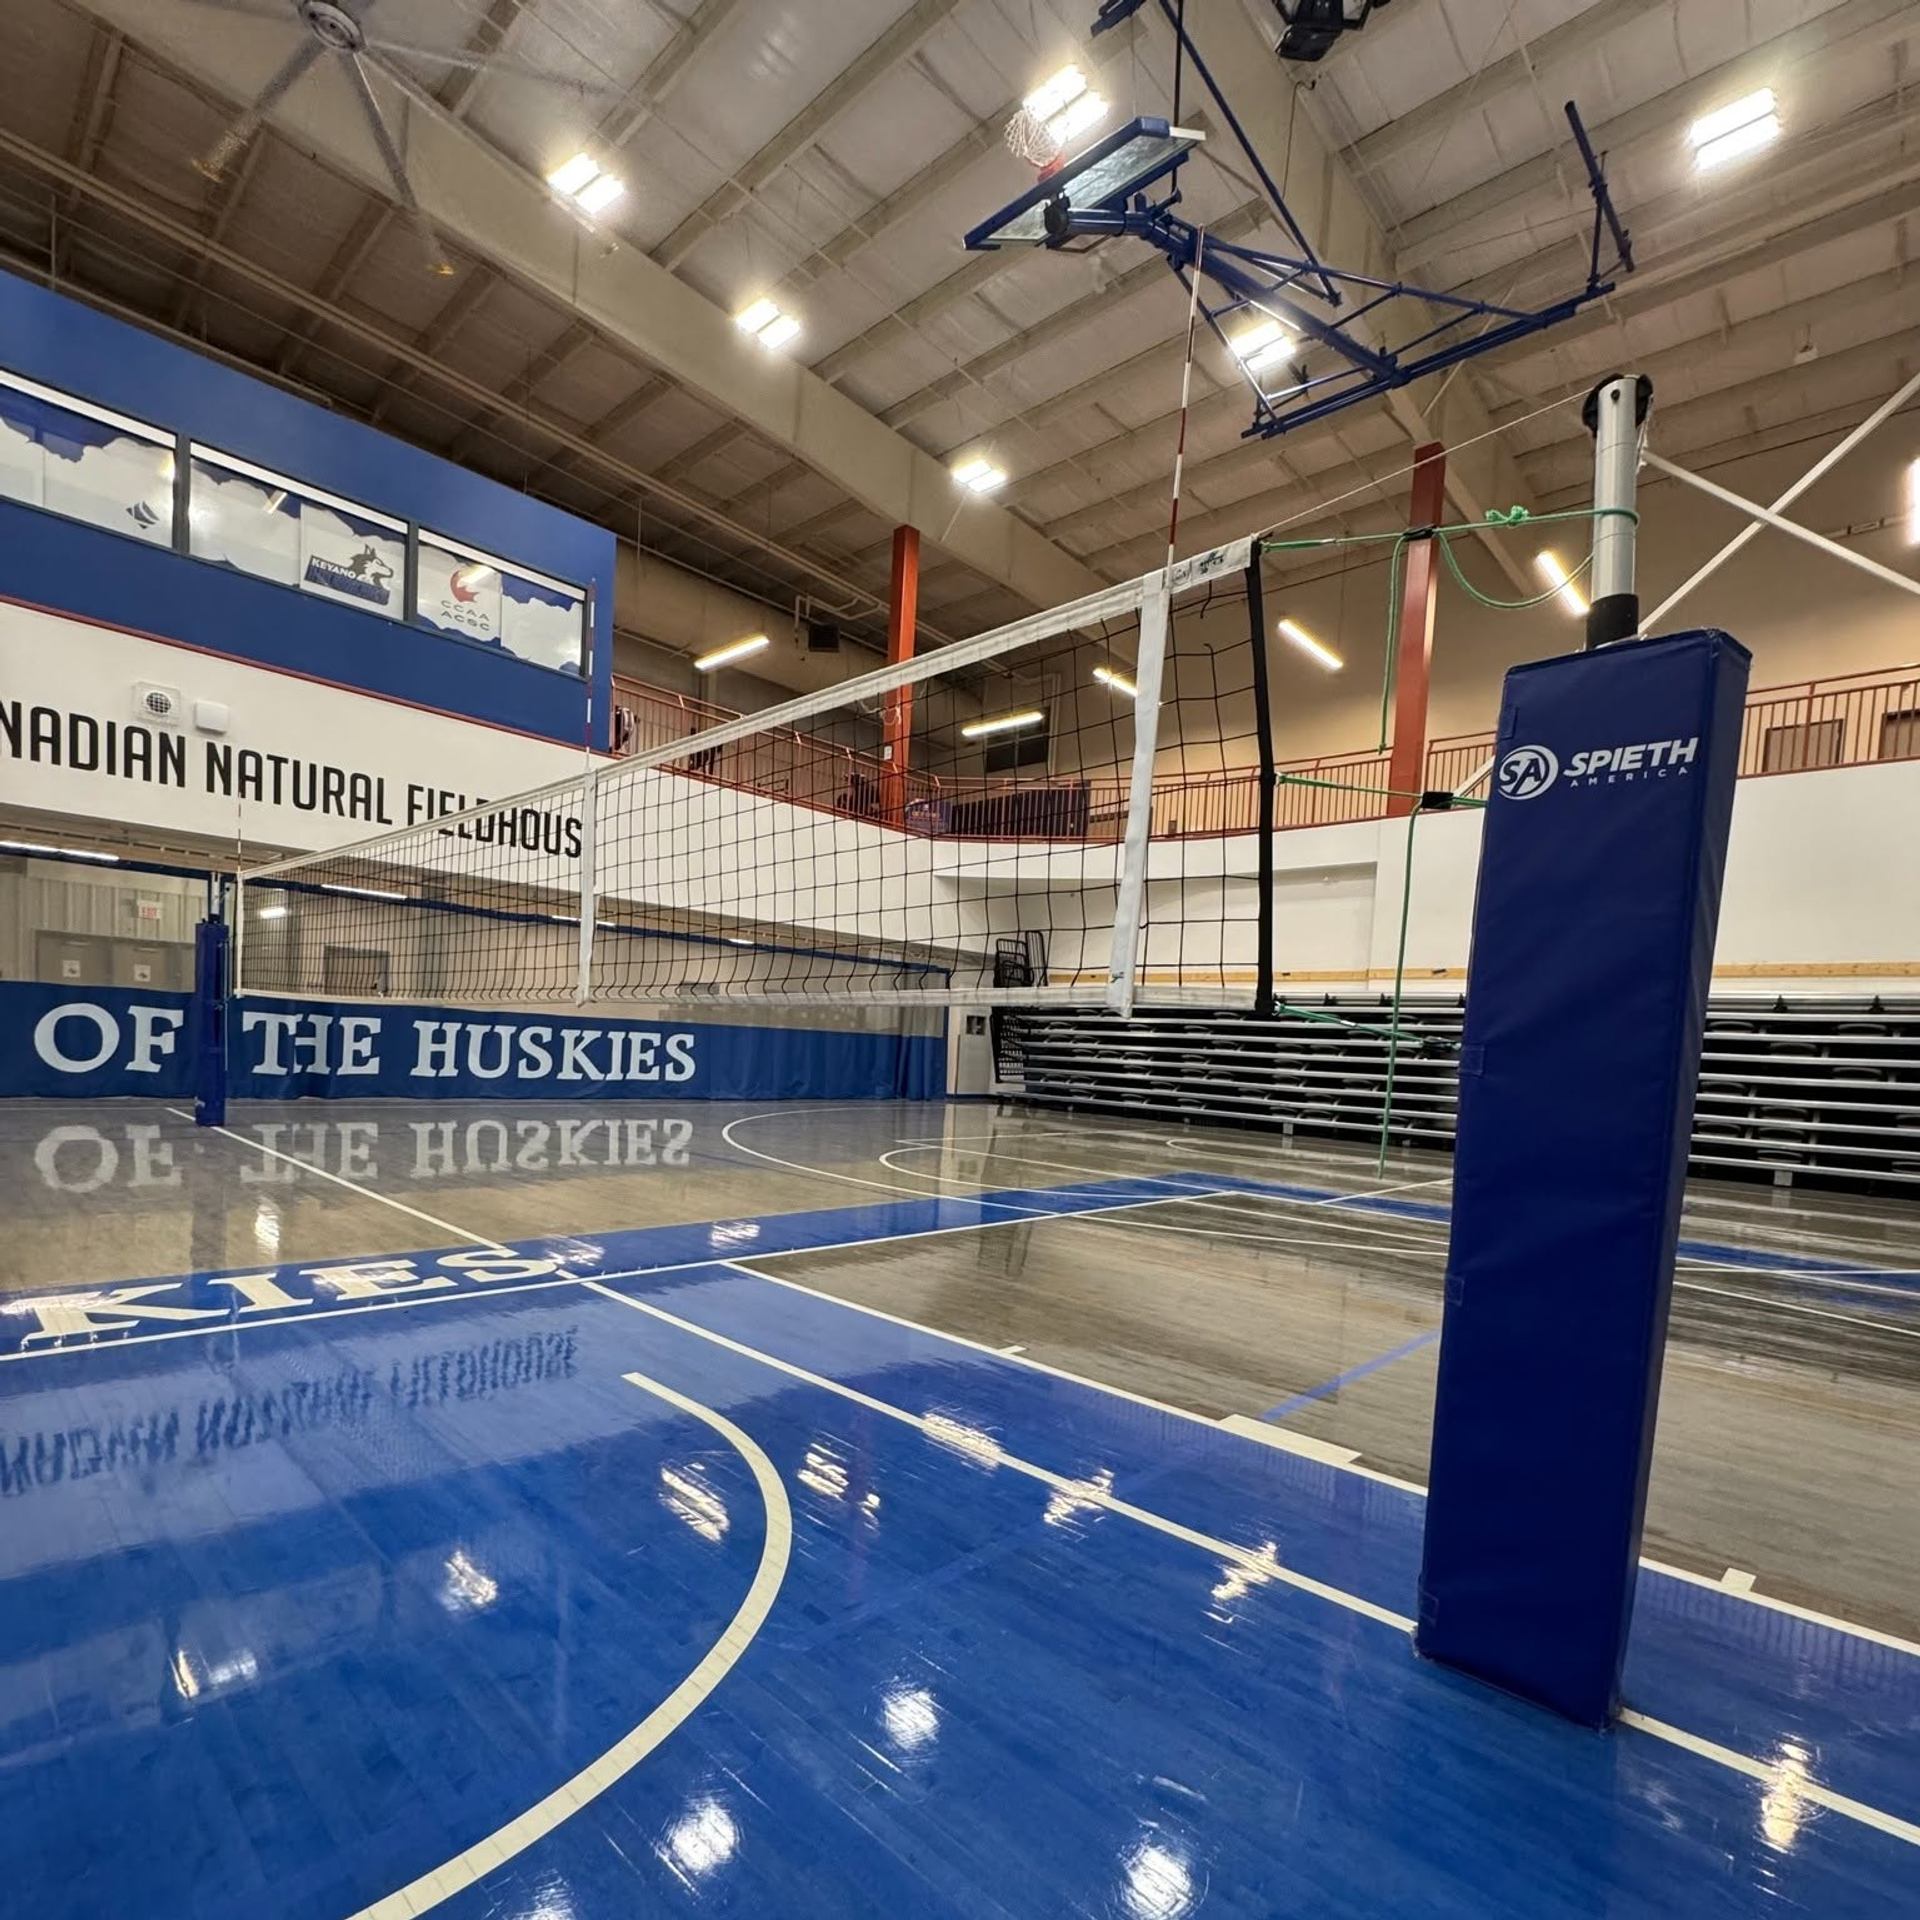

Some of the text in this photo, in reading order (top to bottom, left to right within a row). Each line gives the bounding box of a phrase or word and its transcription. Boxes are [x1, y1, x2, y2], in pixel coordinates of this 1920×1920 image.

[312, 557, 357, 580] KEYANO
[441, 599, 490, 621] CCAA
[441, 610, 490, 631] ACSC
[0, 700, 186, 788] NADIAN
[206, 741, 393, 826] NATURAL
[1563, 737, 1699, 777] SPIETH
[1570, 765, 1688, 788] AMERICA
[34, 1002, 696, 1082] OF THE HUSKIES
[8, 1247, 560, 1340] KIES
